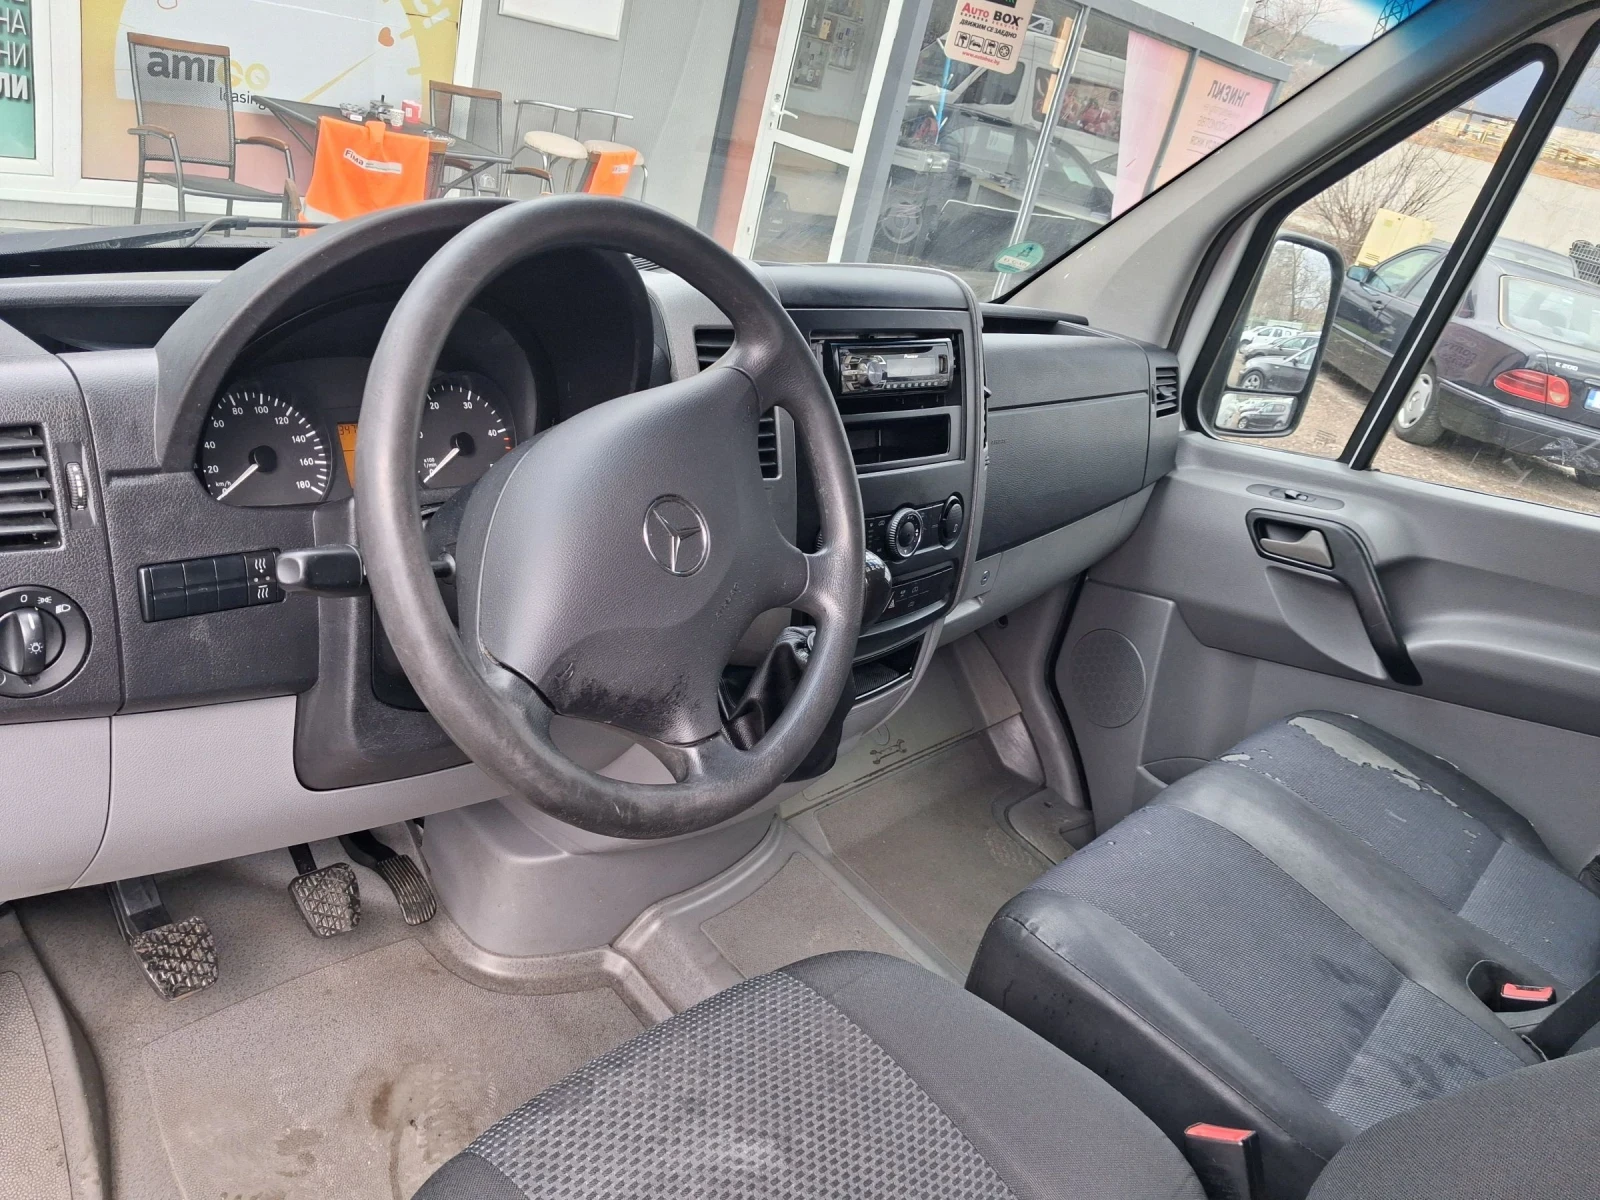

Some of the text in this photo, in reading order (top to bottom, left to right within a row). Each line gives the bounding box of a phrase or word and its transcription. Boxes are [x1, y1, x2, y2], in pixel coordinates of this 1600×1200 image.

[959, 18, 987, 30] ДВИЖИМ
[993, 28, 1018, 39] ЗАЕДНО
[1206, 79, 1250, 108] ЛИЗИНГ
[254, 406, 269, 414] 100
[429, 402, 440, 410] 20
[463, 401, 473, 410] 30
[232, 407, 244, 415] 80
[213, 420, 225, 428] 60
[274, 416, 289, 425] 120
[487, 429, 498, 437] 40
[291, 435, 306, 444] 140
[204, 441, 216, 449] 40
[300, 457, 314, 466] 160
[207, 465, 219, 474] 20
[215, 480, 232, 488] km/h
[296, 480, 311, 489] 180
